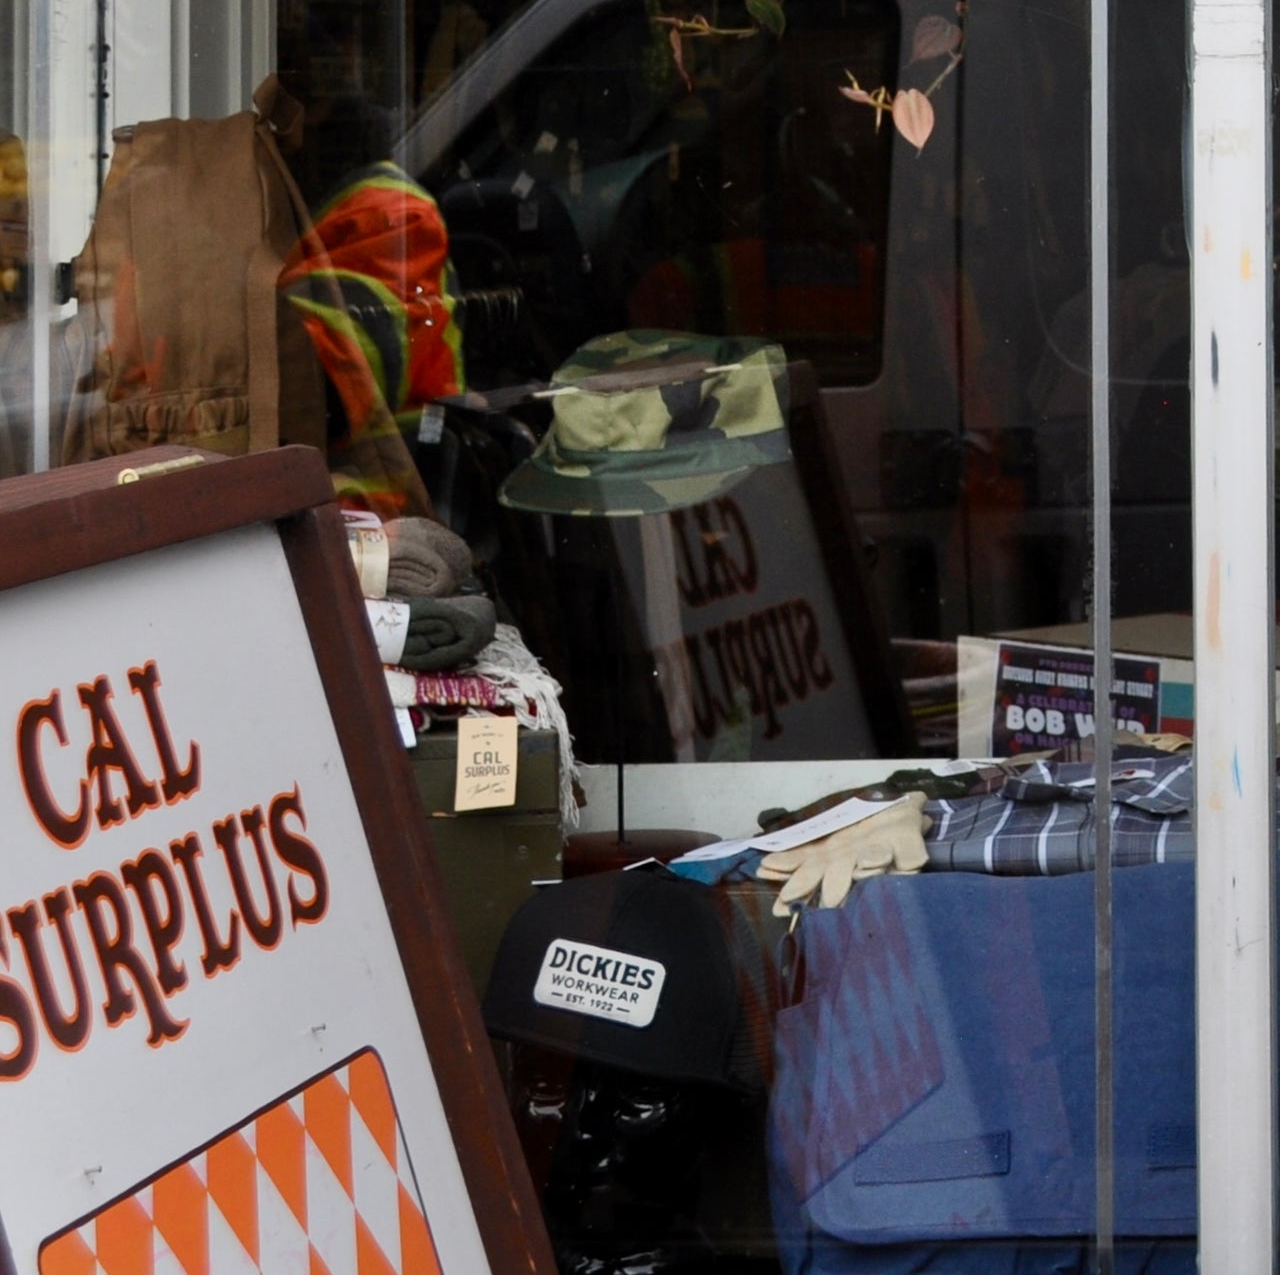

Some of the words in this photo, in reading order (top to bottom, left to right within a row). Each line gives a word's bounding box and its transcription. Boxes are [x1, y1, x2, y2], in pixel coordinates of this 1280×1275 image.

[1029, 694, 1117, 713] CELEBRAT
[1006, 705, 1065, 735] BOB
[15, 659, 203, 851] CAL
[473, 751, 502, 765] CAL
[465, 765, 510, 778] SURPLUS
[0, 781, 331, 1083] SURPLUS
[549, 946, 656, 990] DICKIES
[551, 973, 640, 1005] WORKWEAR
[565, 993, 586, 1005] EST.
[590, 999, 614, 1012] 1922
